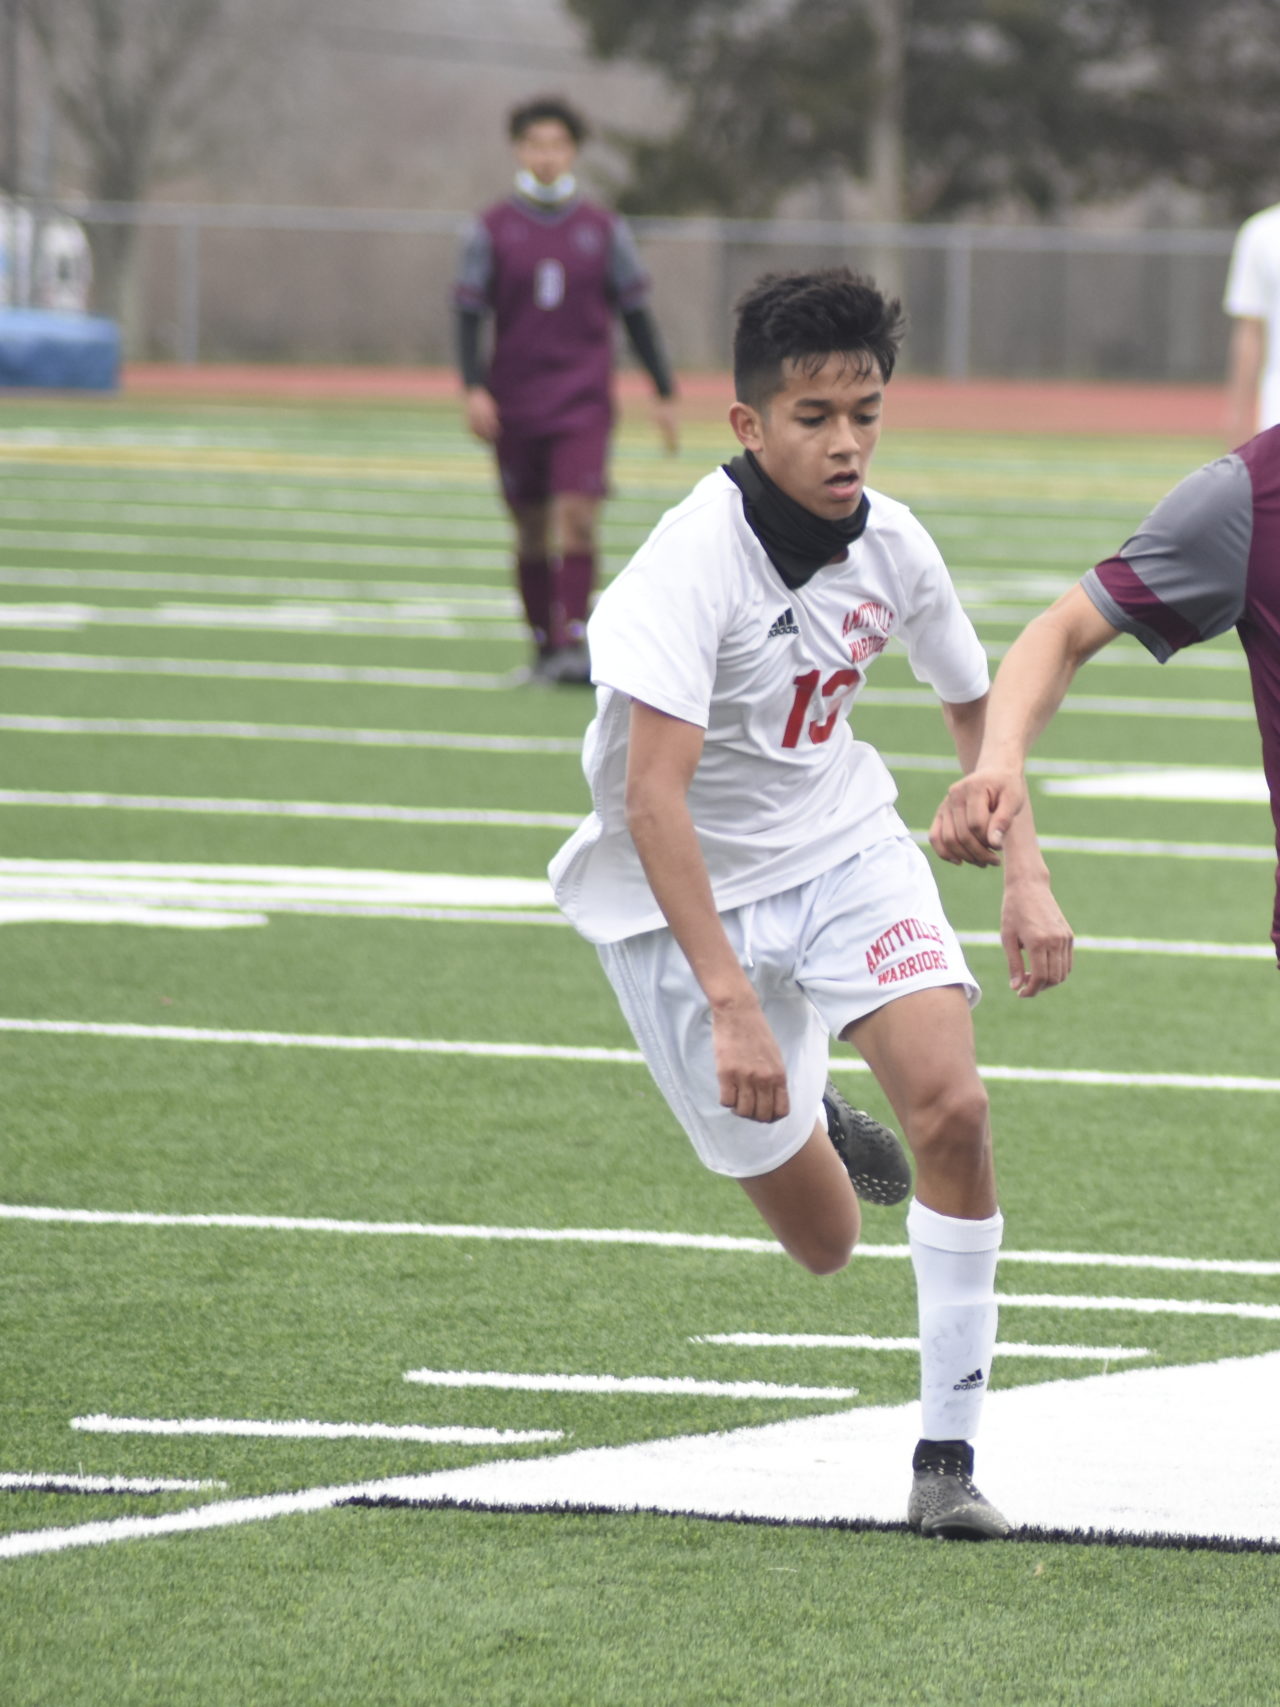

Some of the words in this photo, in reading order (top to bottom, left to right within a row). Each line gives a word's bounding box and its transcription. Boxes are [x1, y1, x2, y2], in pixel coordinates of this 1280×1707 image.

[782, 668, 861, 748] 13
[865, 918, 945, 975] AMITYVILLE
[877, 950, 949, 986] WARRIORS
